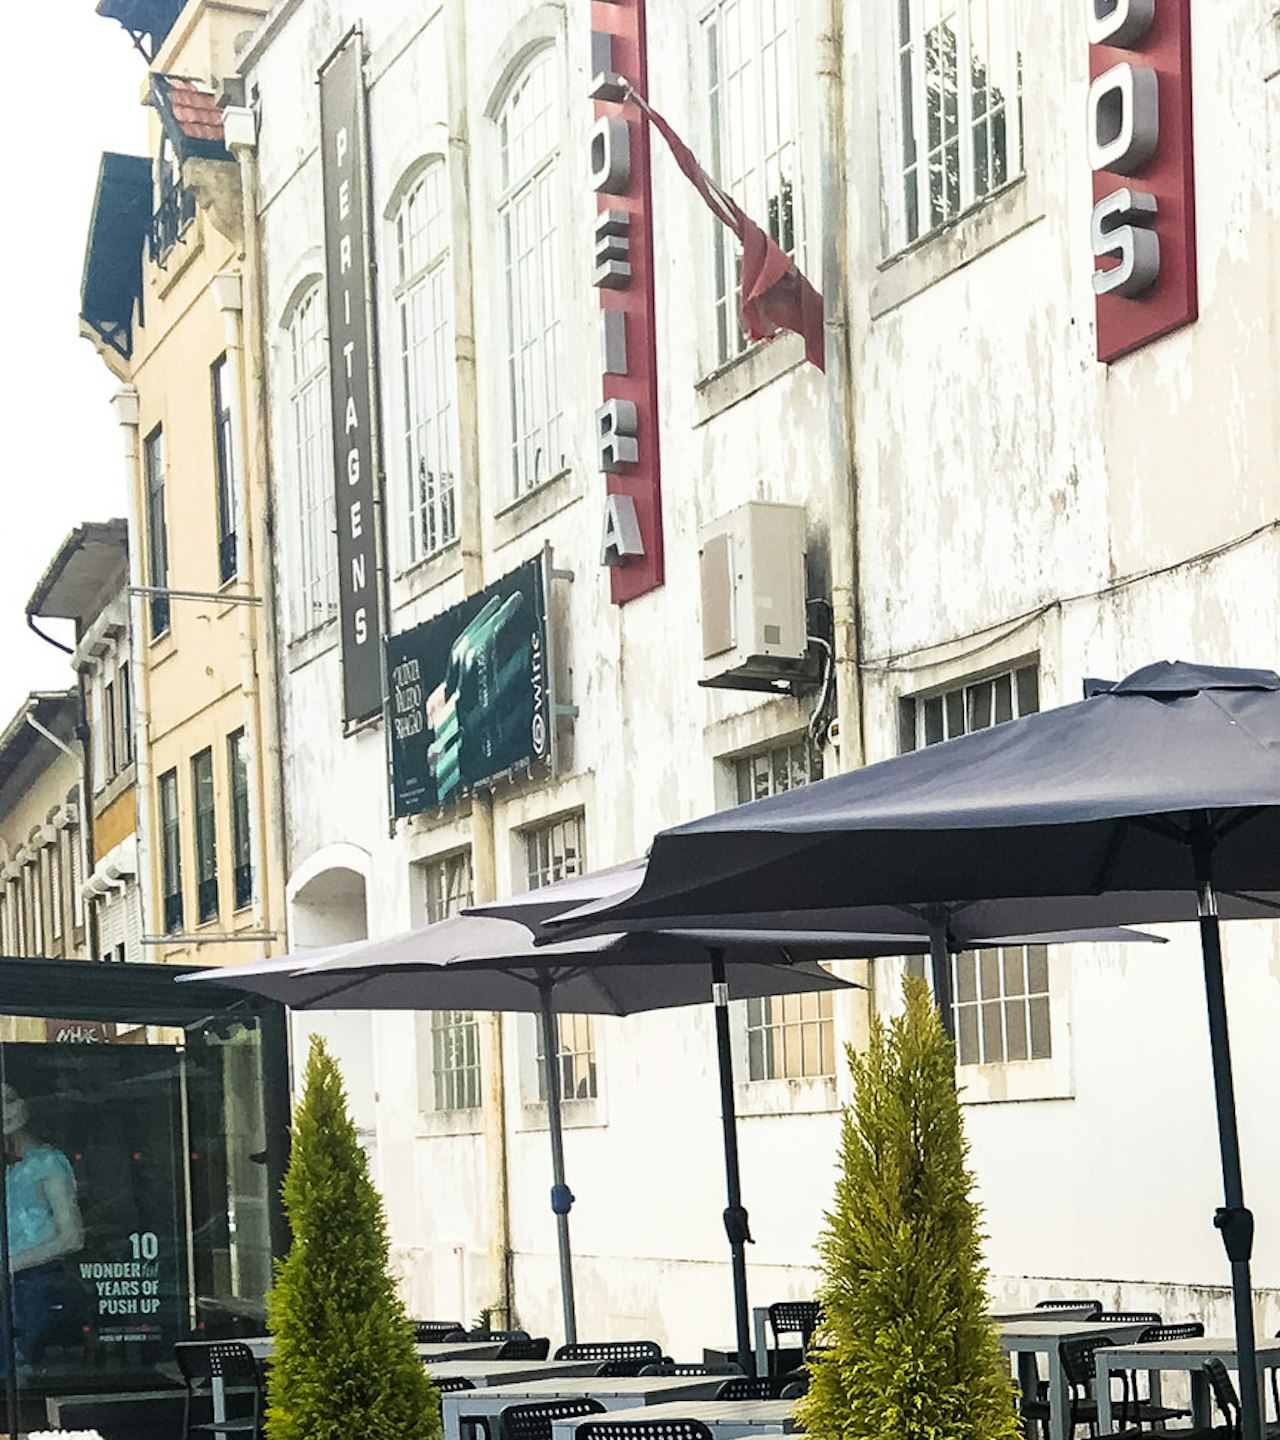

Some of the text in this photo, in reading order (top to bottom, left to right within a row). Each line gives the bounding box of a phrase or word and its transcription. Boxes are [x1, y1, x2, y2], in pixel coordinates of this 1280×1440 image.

[336, 127, 368, 647] PERITAGENS
[129, 1232, 158, 1260] 10
[96, 1280, 159, 1296] YEARS OF
[99, 1299, 160, 1314] PUSH UP
